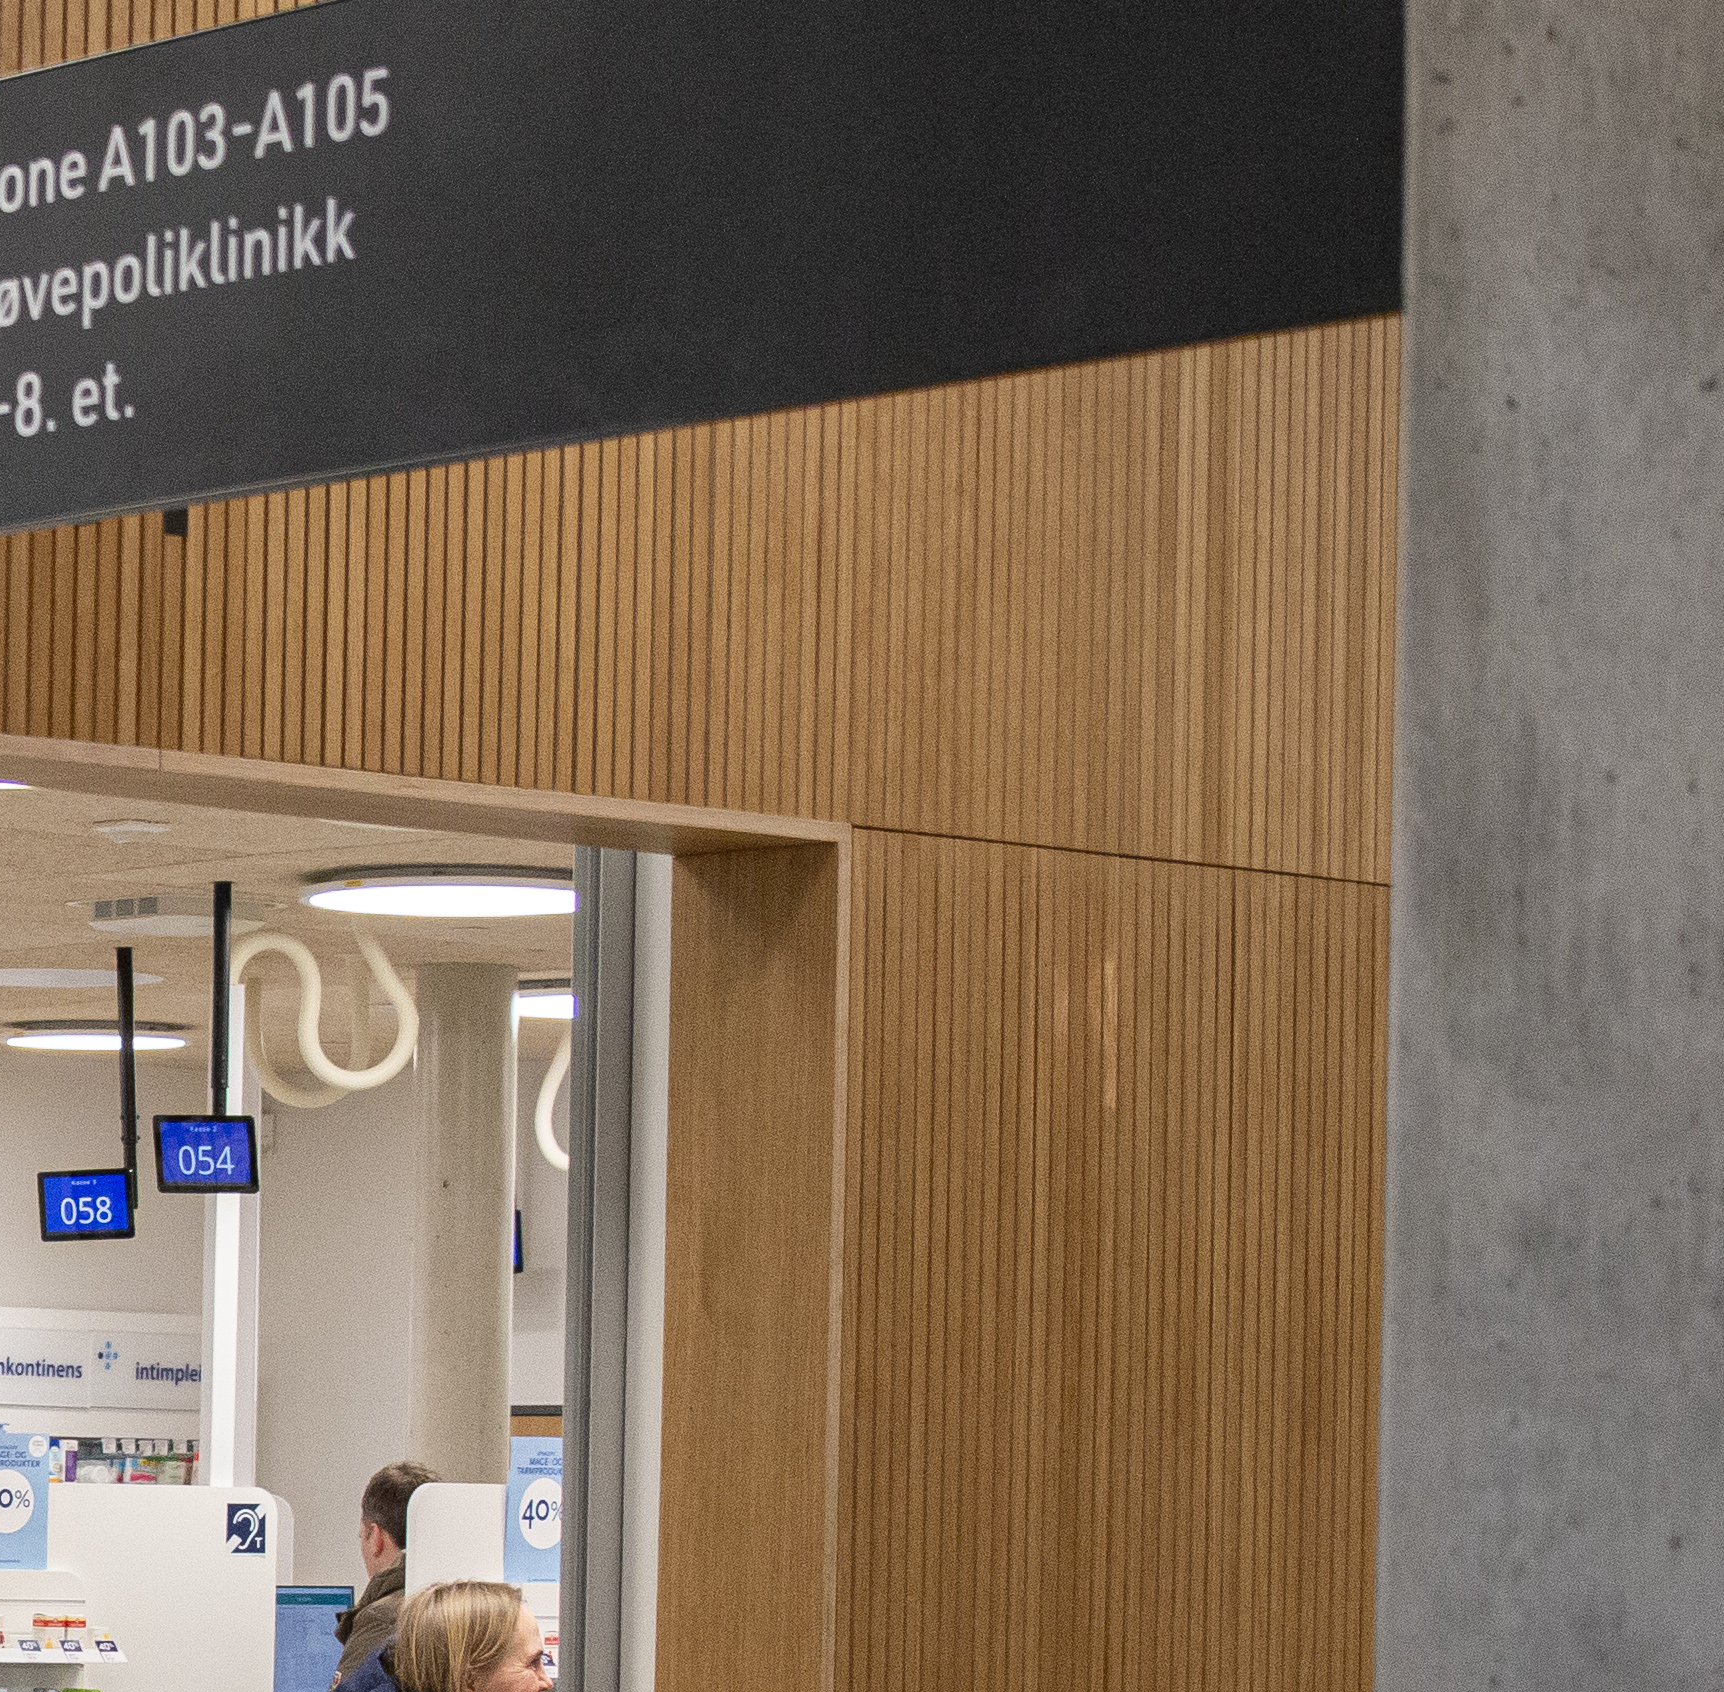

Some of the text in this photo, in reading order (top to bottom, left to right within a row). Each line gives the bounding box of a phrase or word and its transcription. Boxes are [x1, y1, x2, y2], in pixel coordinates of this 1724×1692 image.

[98, 68, 390, 193] A103-A105
[73, 362, 136, 429] et.
[178, 1145, 235, 1176] 054
[60, 1196, 112, 1225] 058
